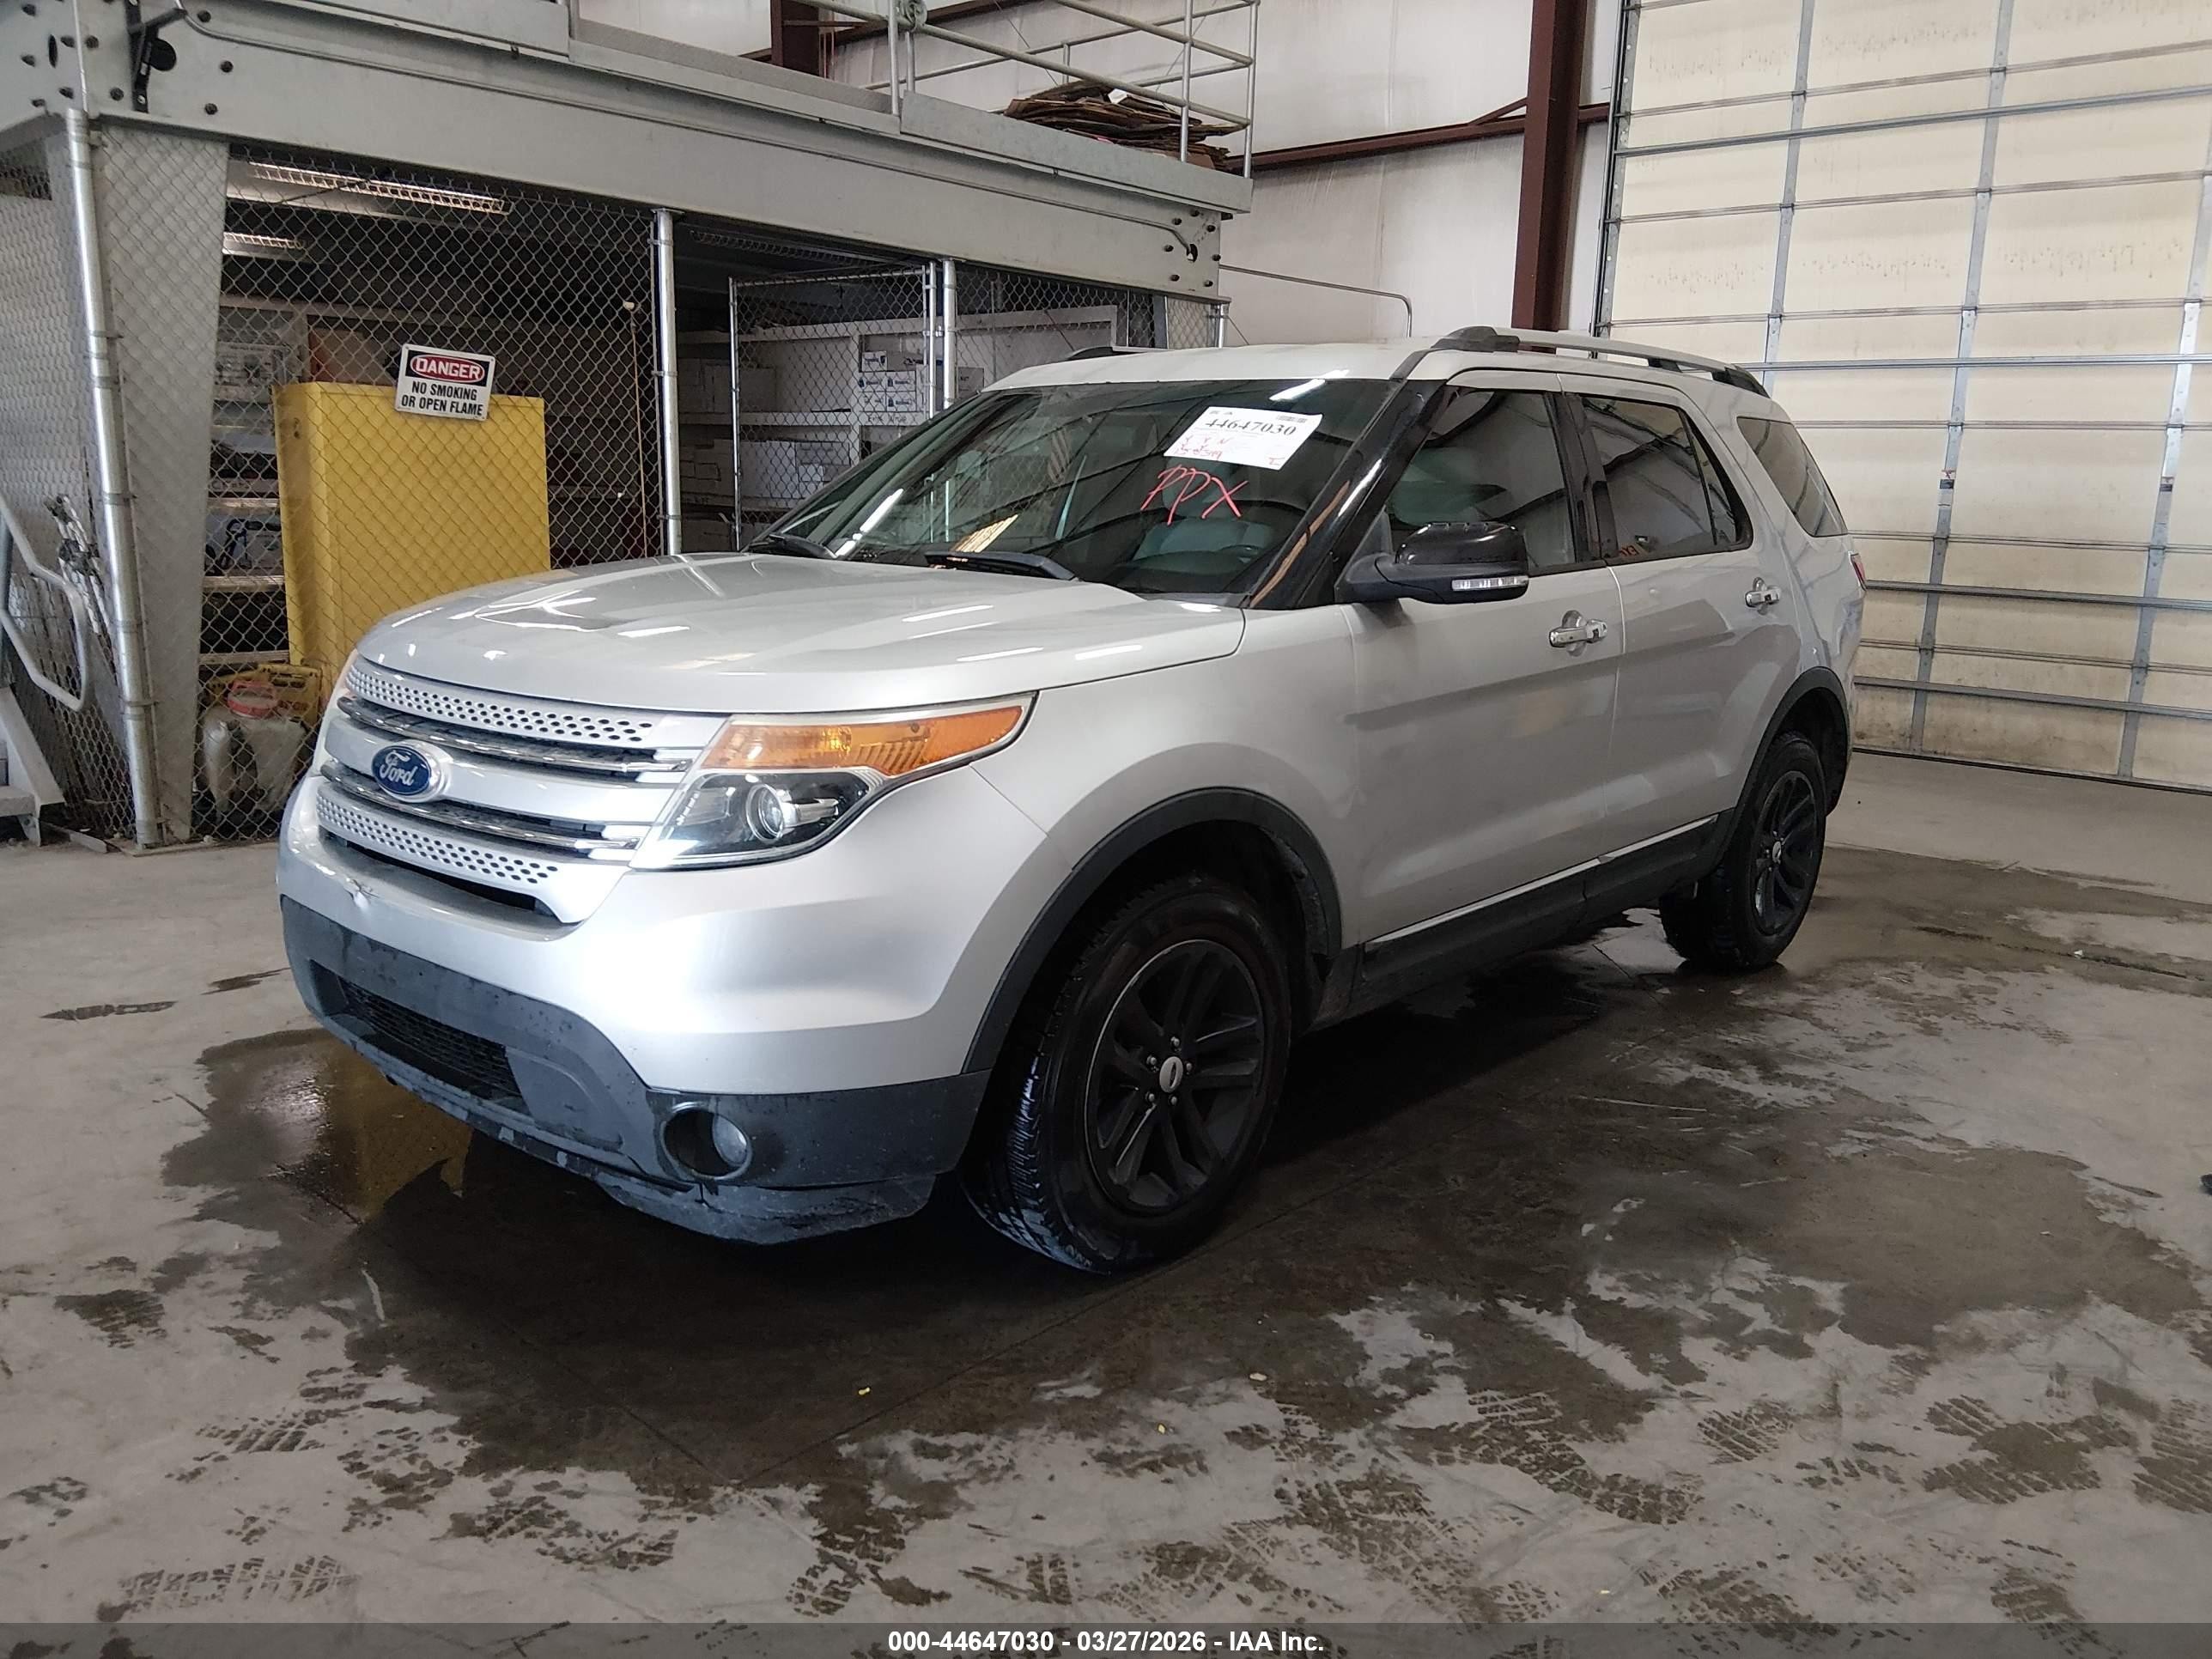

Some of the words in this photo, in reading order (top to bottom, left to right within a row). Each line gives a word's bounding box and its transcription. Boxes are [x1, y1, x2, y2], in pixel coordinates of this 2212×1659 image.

[416, 357, 481, 380] DANGER
[412, 380, 428, 395] NO
[430, 383, 478, 401] SMOKING
[401, 394, 416, 408] OR
[419, 397, 447, 412] OPEN
[450, 400, 483, 416] FLAME
[1205, 418, 1297, 436] 44647030
[1139, 465, 1249, 526] PPX
[379, 750, 419, 787] Ford
